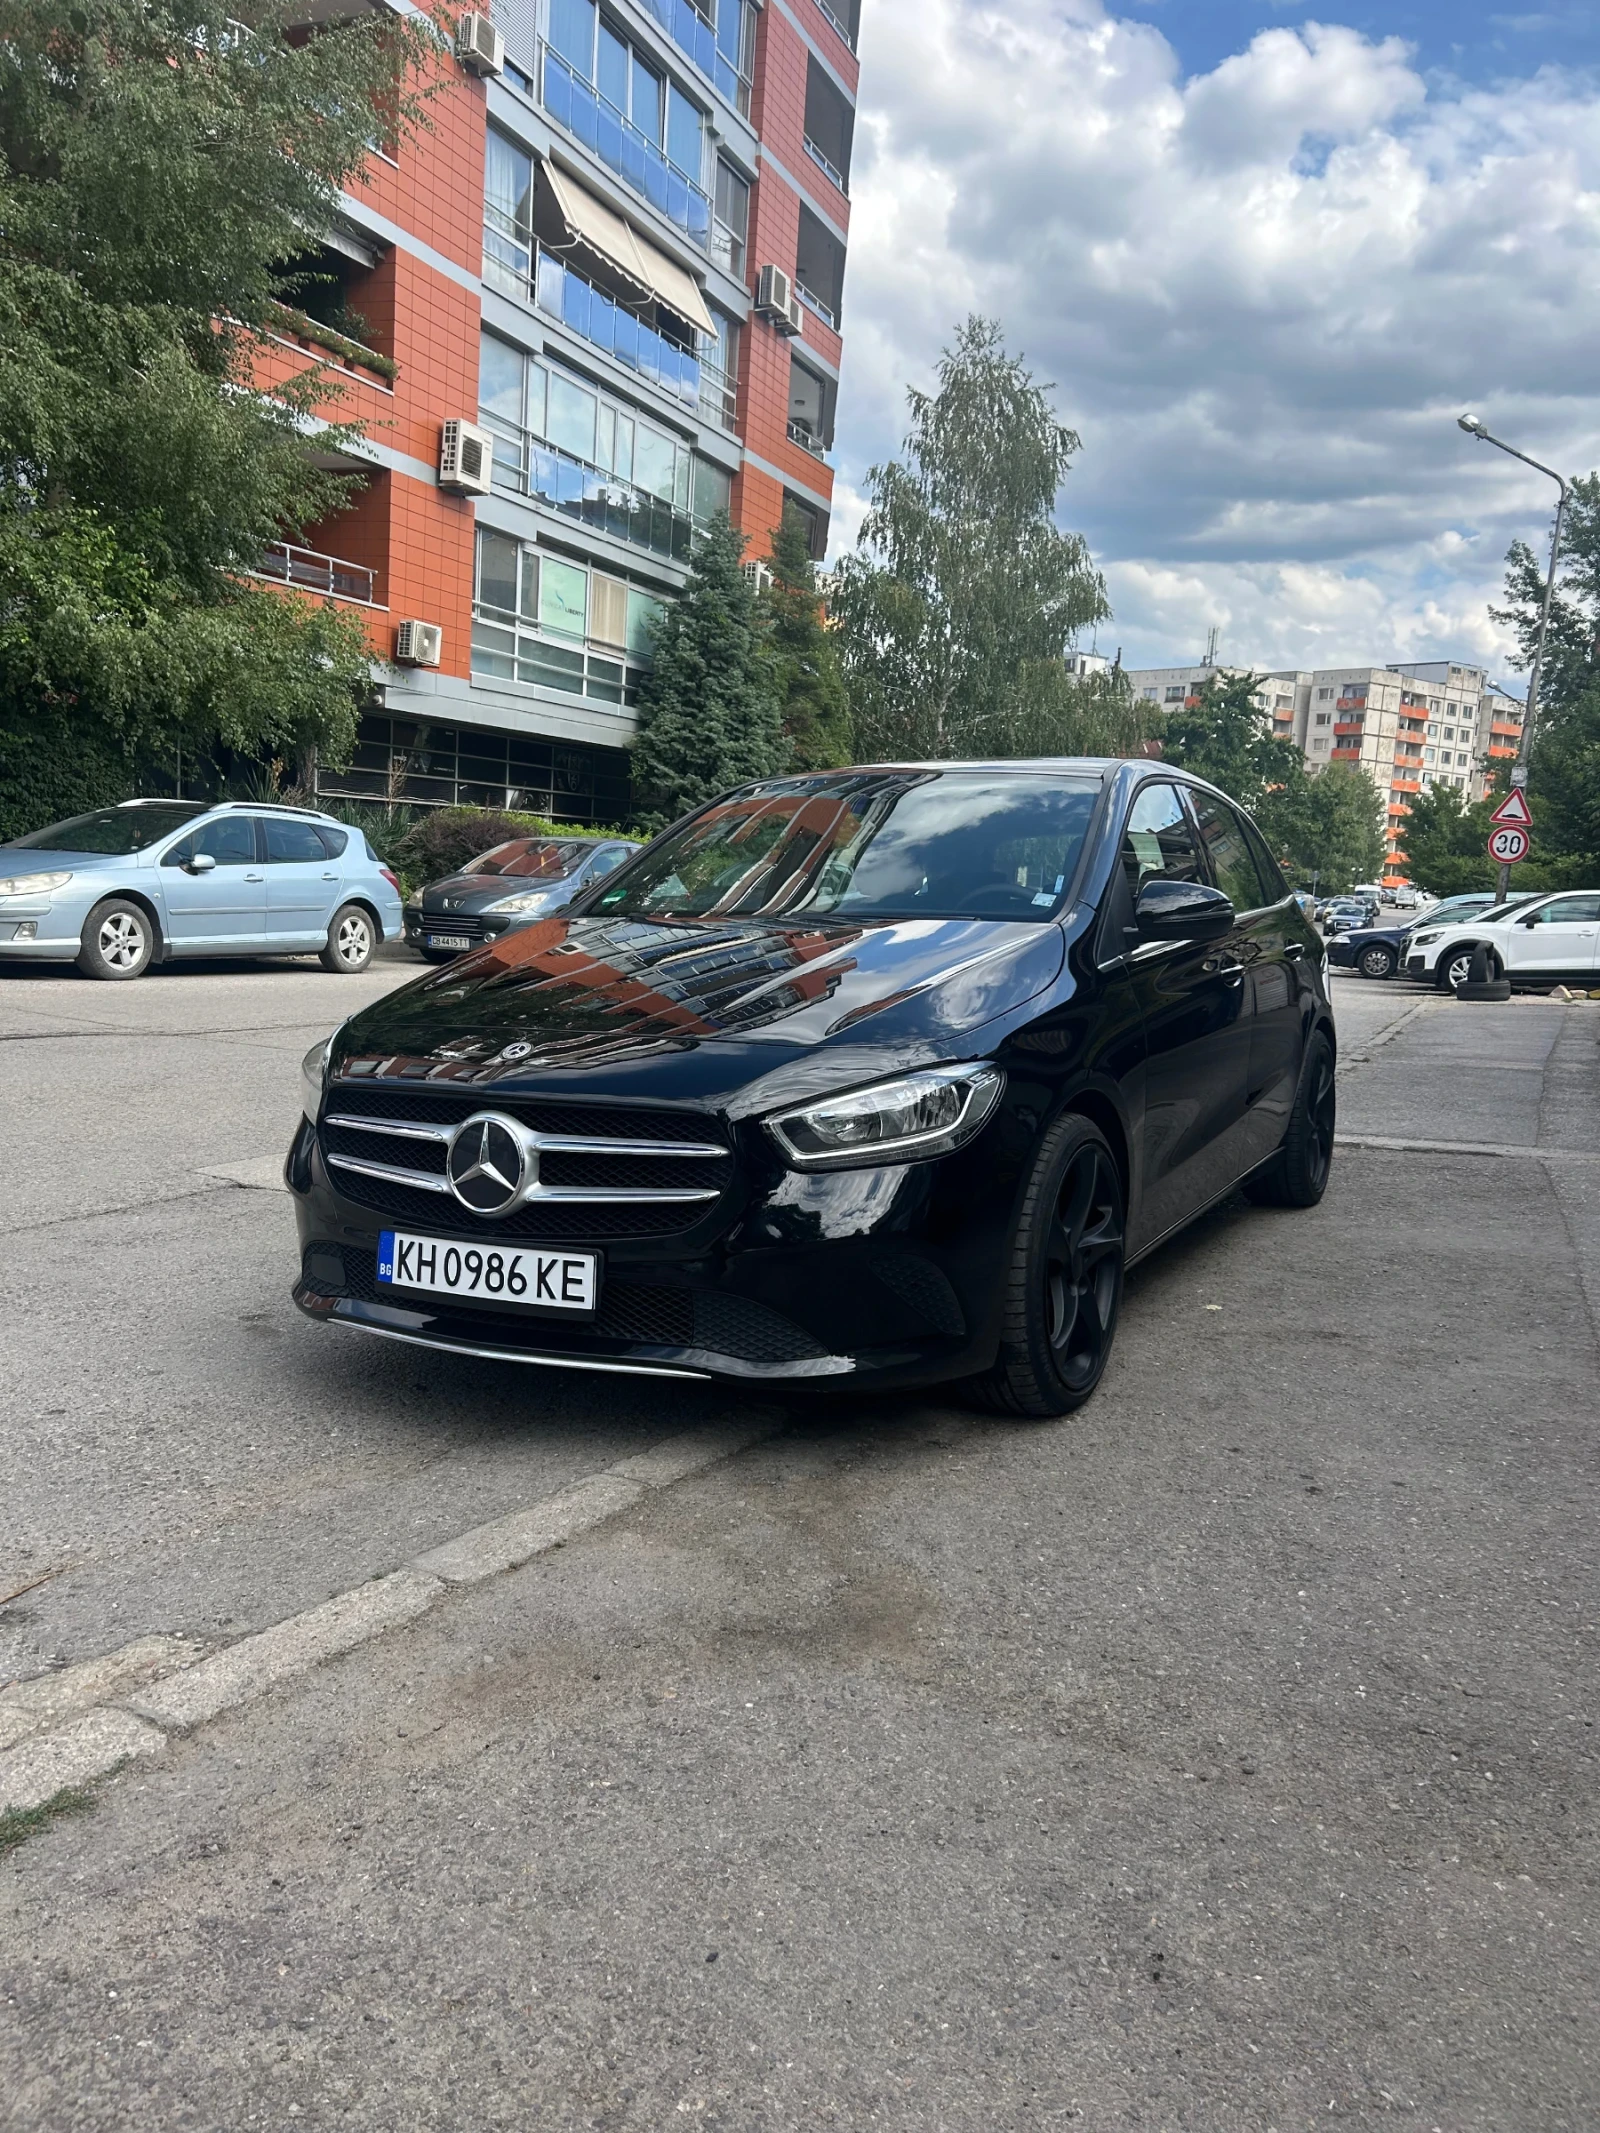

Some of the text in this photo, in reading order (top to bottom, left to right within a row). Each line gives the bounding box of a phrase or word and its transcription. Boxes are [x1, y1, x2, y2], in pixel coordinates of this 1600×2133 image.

[564, 606, 584, 618] LIBERTY
[1496, 834, 1521, 854] 30
[379, 1263, 392, 1276] BG
